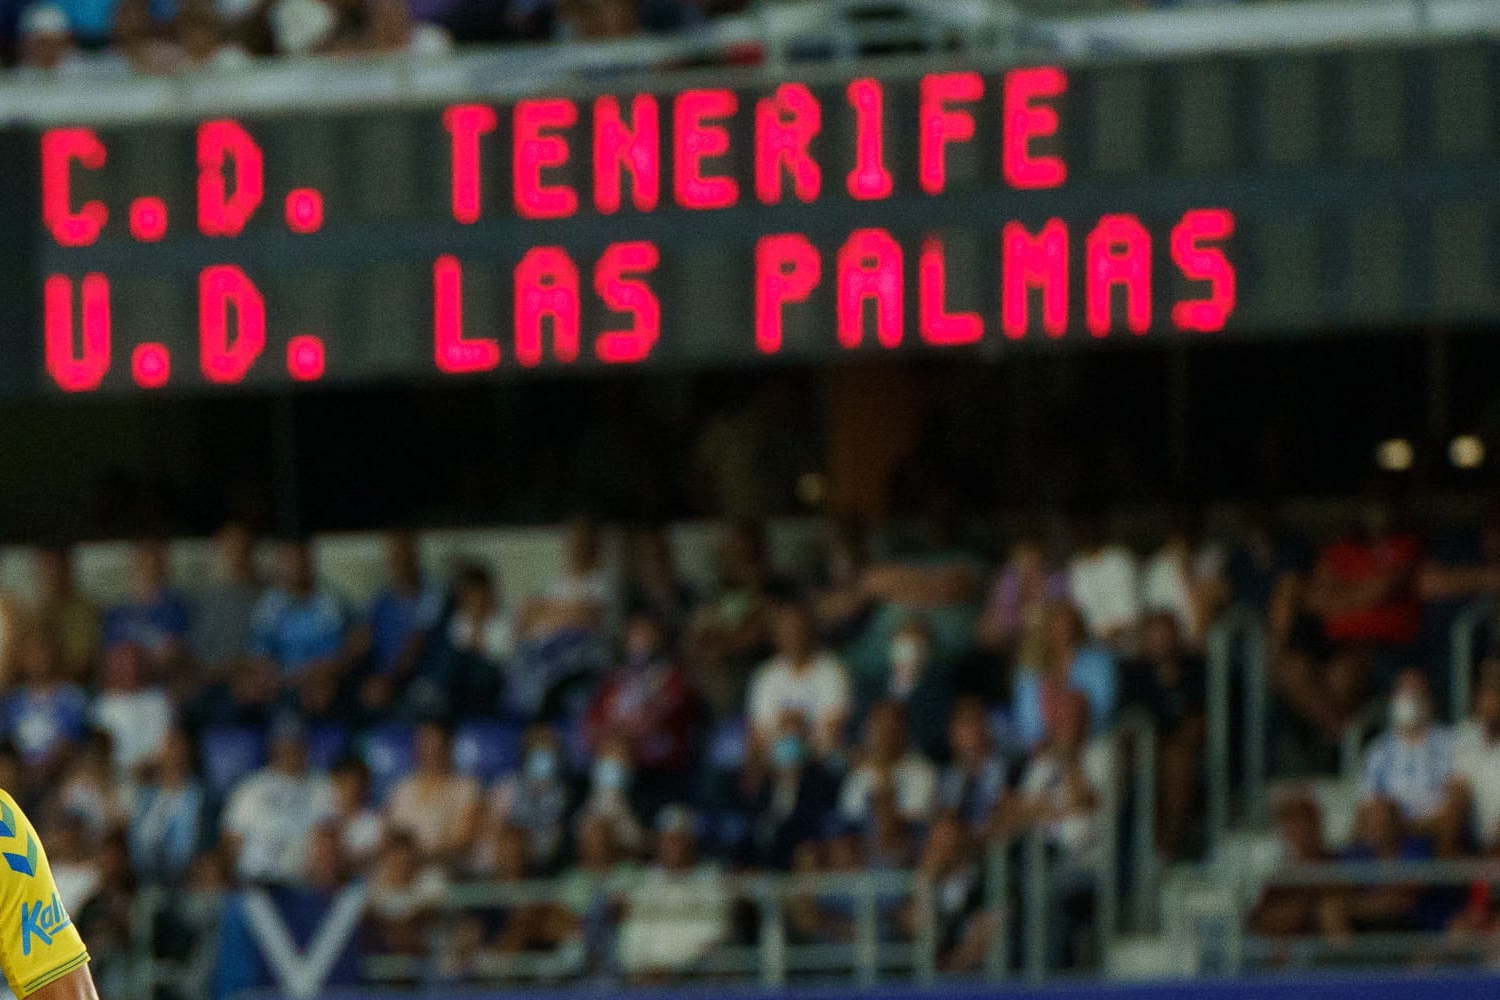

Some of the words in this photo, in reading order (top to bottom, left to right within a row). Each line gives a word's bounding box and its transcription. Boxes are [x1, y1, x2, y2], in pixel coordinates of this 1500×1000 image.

[443, 65, 1068, 224] TENERIFE
[433, 240, 660, 373] LAS
[754, 207, 1236, 354] PALMAS
